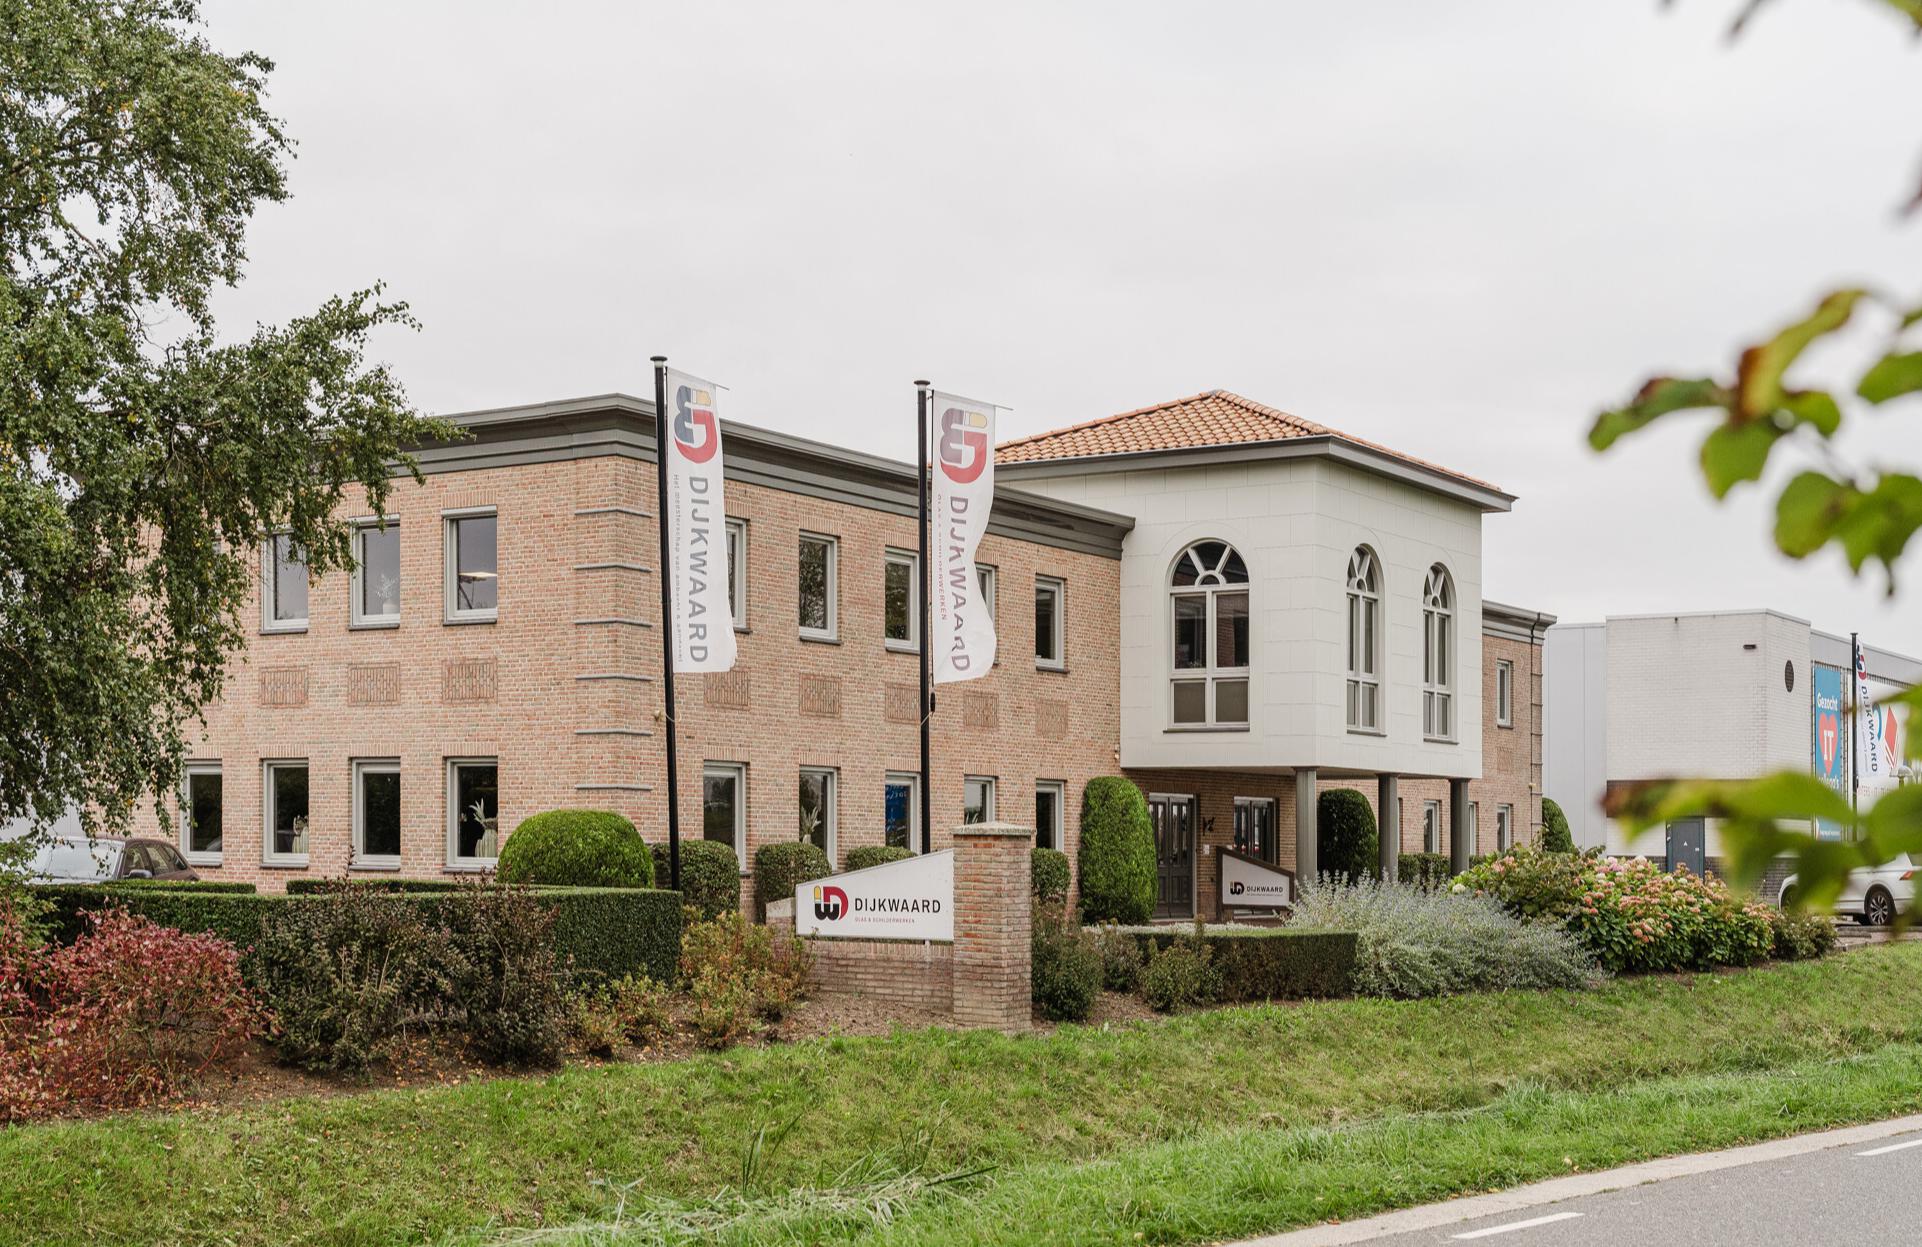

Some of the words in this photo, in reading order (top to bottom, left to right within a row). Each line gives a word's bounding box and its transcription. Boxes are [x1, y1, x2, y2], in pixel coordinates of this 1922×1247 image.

[689, 476, 709, 662] DIJKWAARD
[949, 496, 970, 672] DIJKWAARD
[1817, 691, 1838, 711] Gezocht
[1861, 685, 1878, 772] DIJKWAARD
[1824, 729, 1834, 761] IT
[1246, 885, 1283, 893] DIJKWAARD
[854, 897, 941, 914] DIJKWAARD
